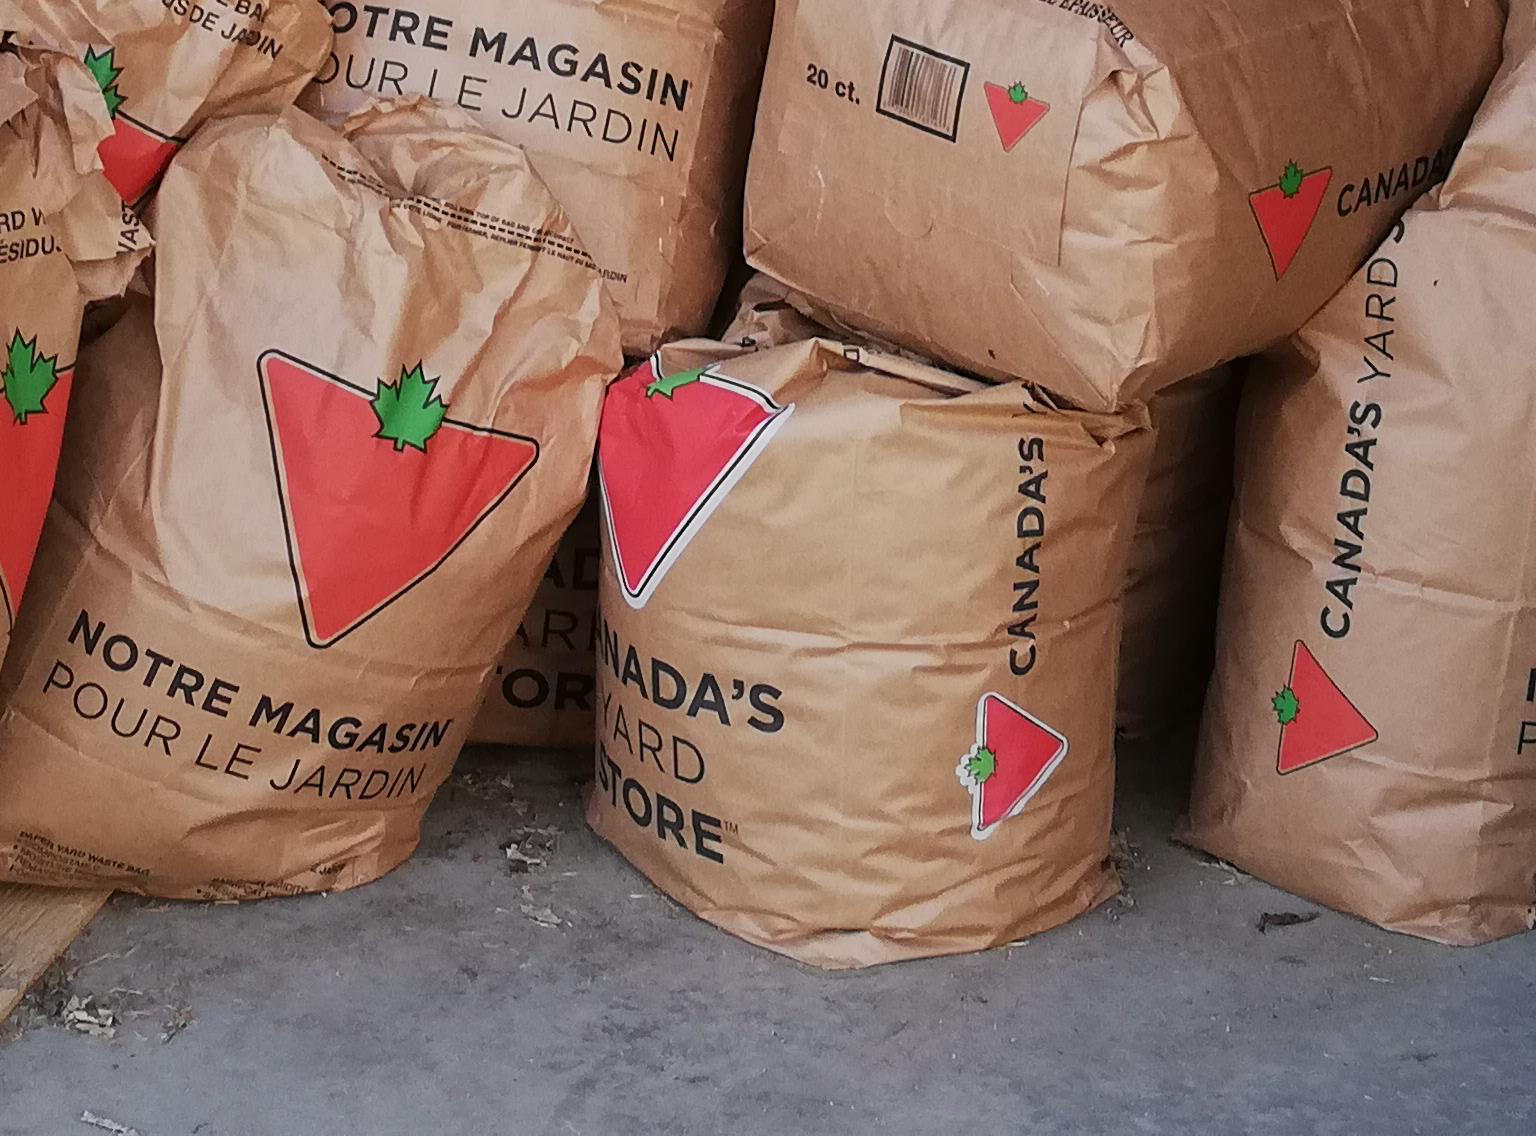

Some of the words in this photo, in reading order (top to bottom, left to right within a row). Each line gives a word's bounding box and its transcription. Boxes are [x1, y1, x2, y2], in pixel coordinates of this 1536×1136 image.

[189, 3, 221, 31] DE
[330, 0, 454, 52] OTRE
[468, 27, 689, 111] MAGASIN
[314, 52, 407, 97] OUR
[502, 87, 680, 163] JARDIN
[806, 63, 829, 90] 20
[835, 81, 860, 105] ct.
[1321, 400, 1382, 639] CANADA'S
[1357, 257, 1399, 384] YARD
[1007, 435, 1050, 676] CANADA'S
[42, 660, 182, 757] POUR
[194, 733, 262, 781] LE
[269, 759, 427, 801] JARDIN
[67, 608, 241, 718] NOTRE
[248, 693, 454, 754] MAGASIN
[600, 620, 785, 734] NADA'S
[602, 692, 705, 784] YARD
